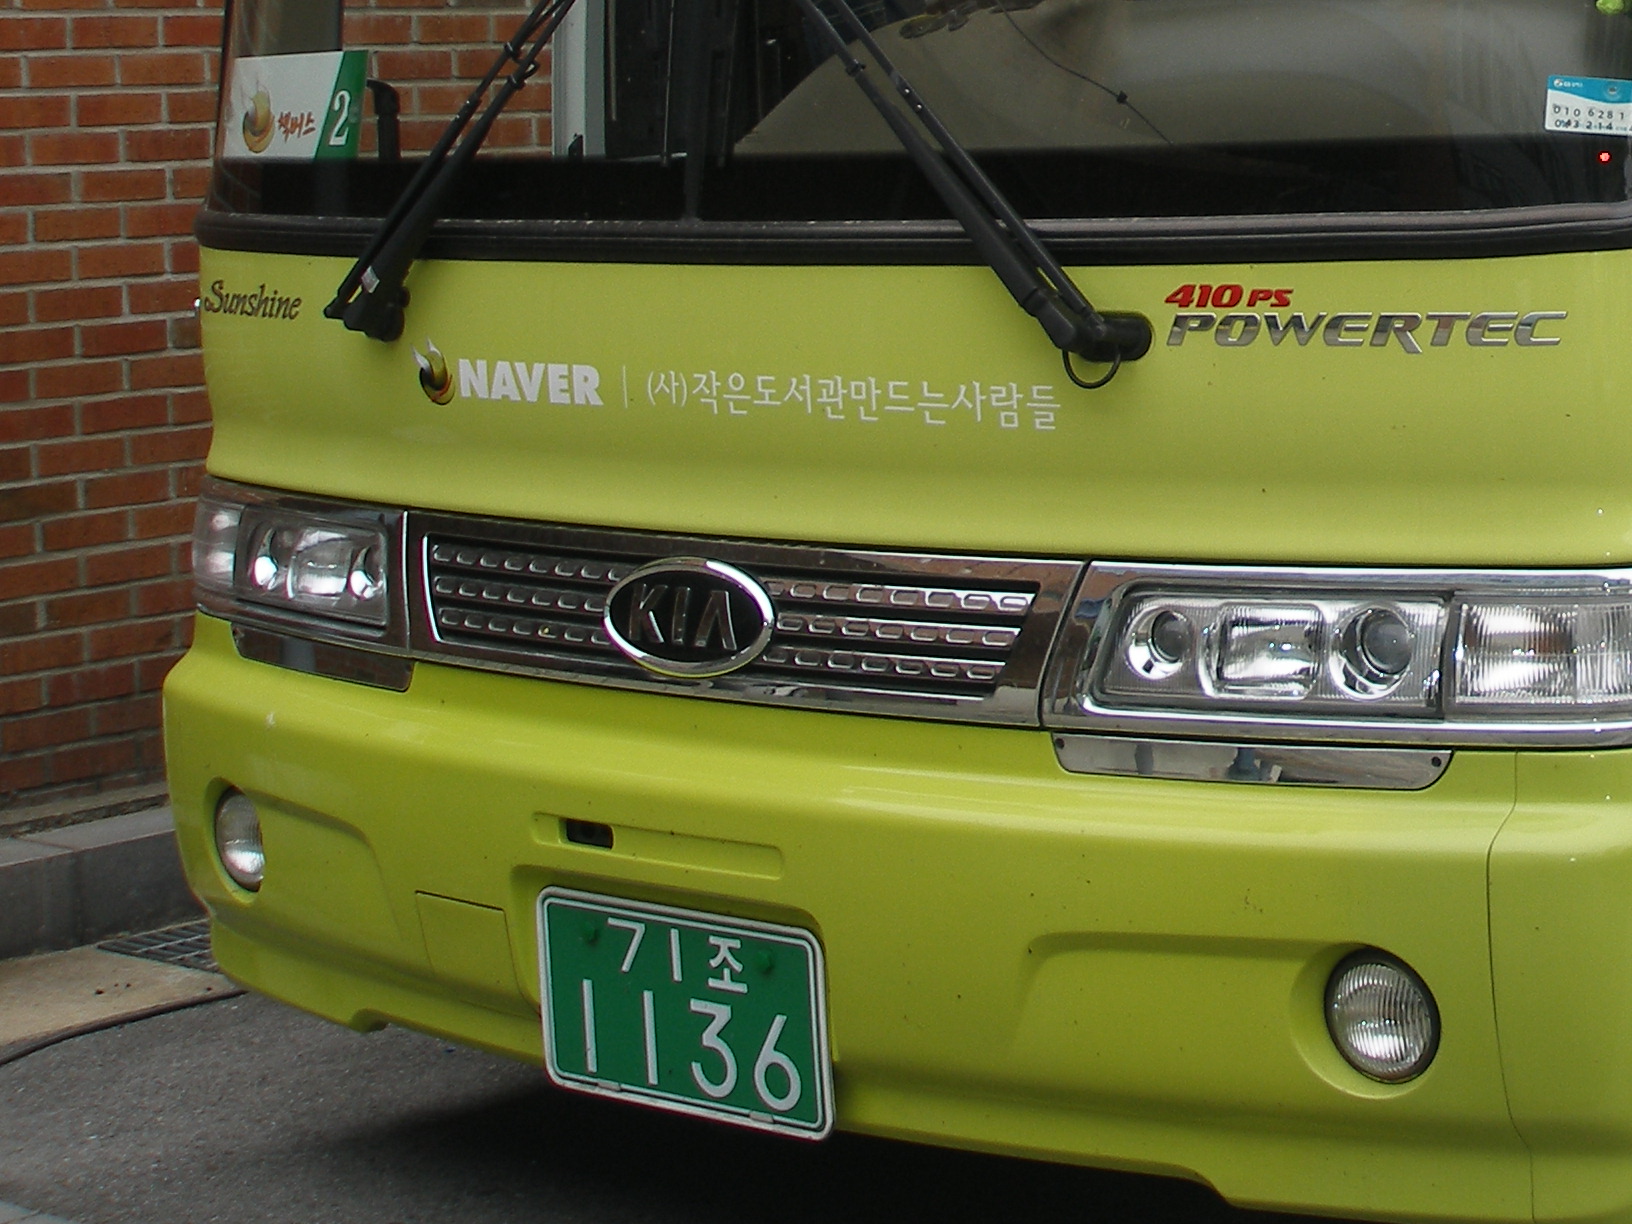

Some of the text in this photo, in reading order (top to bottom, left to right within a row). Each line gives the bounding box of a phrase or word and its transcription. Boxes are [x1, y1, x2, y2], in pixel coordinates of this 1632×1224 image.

[329, 90, 351, 146] 2
[1553, 105, 1580, 117] 010
[1588, 108, 1625, 120] 6281
[204, 280, 302, 320] Sunshine
[1164, 283, 1294, 308] 410 PS
[1166, 311, 1569, 354] POWERTEC
[458, 358, 604, 406] NAVER
[629, 583, 738, 651] KIA
[582, 978, 802, 1112] 1136
